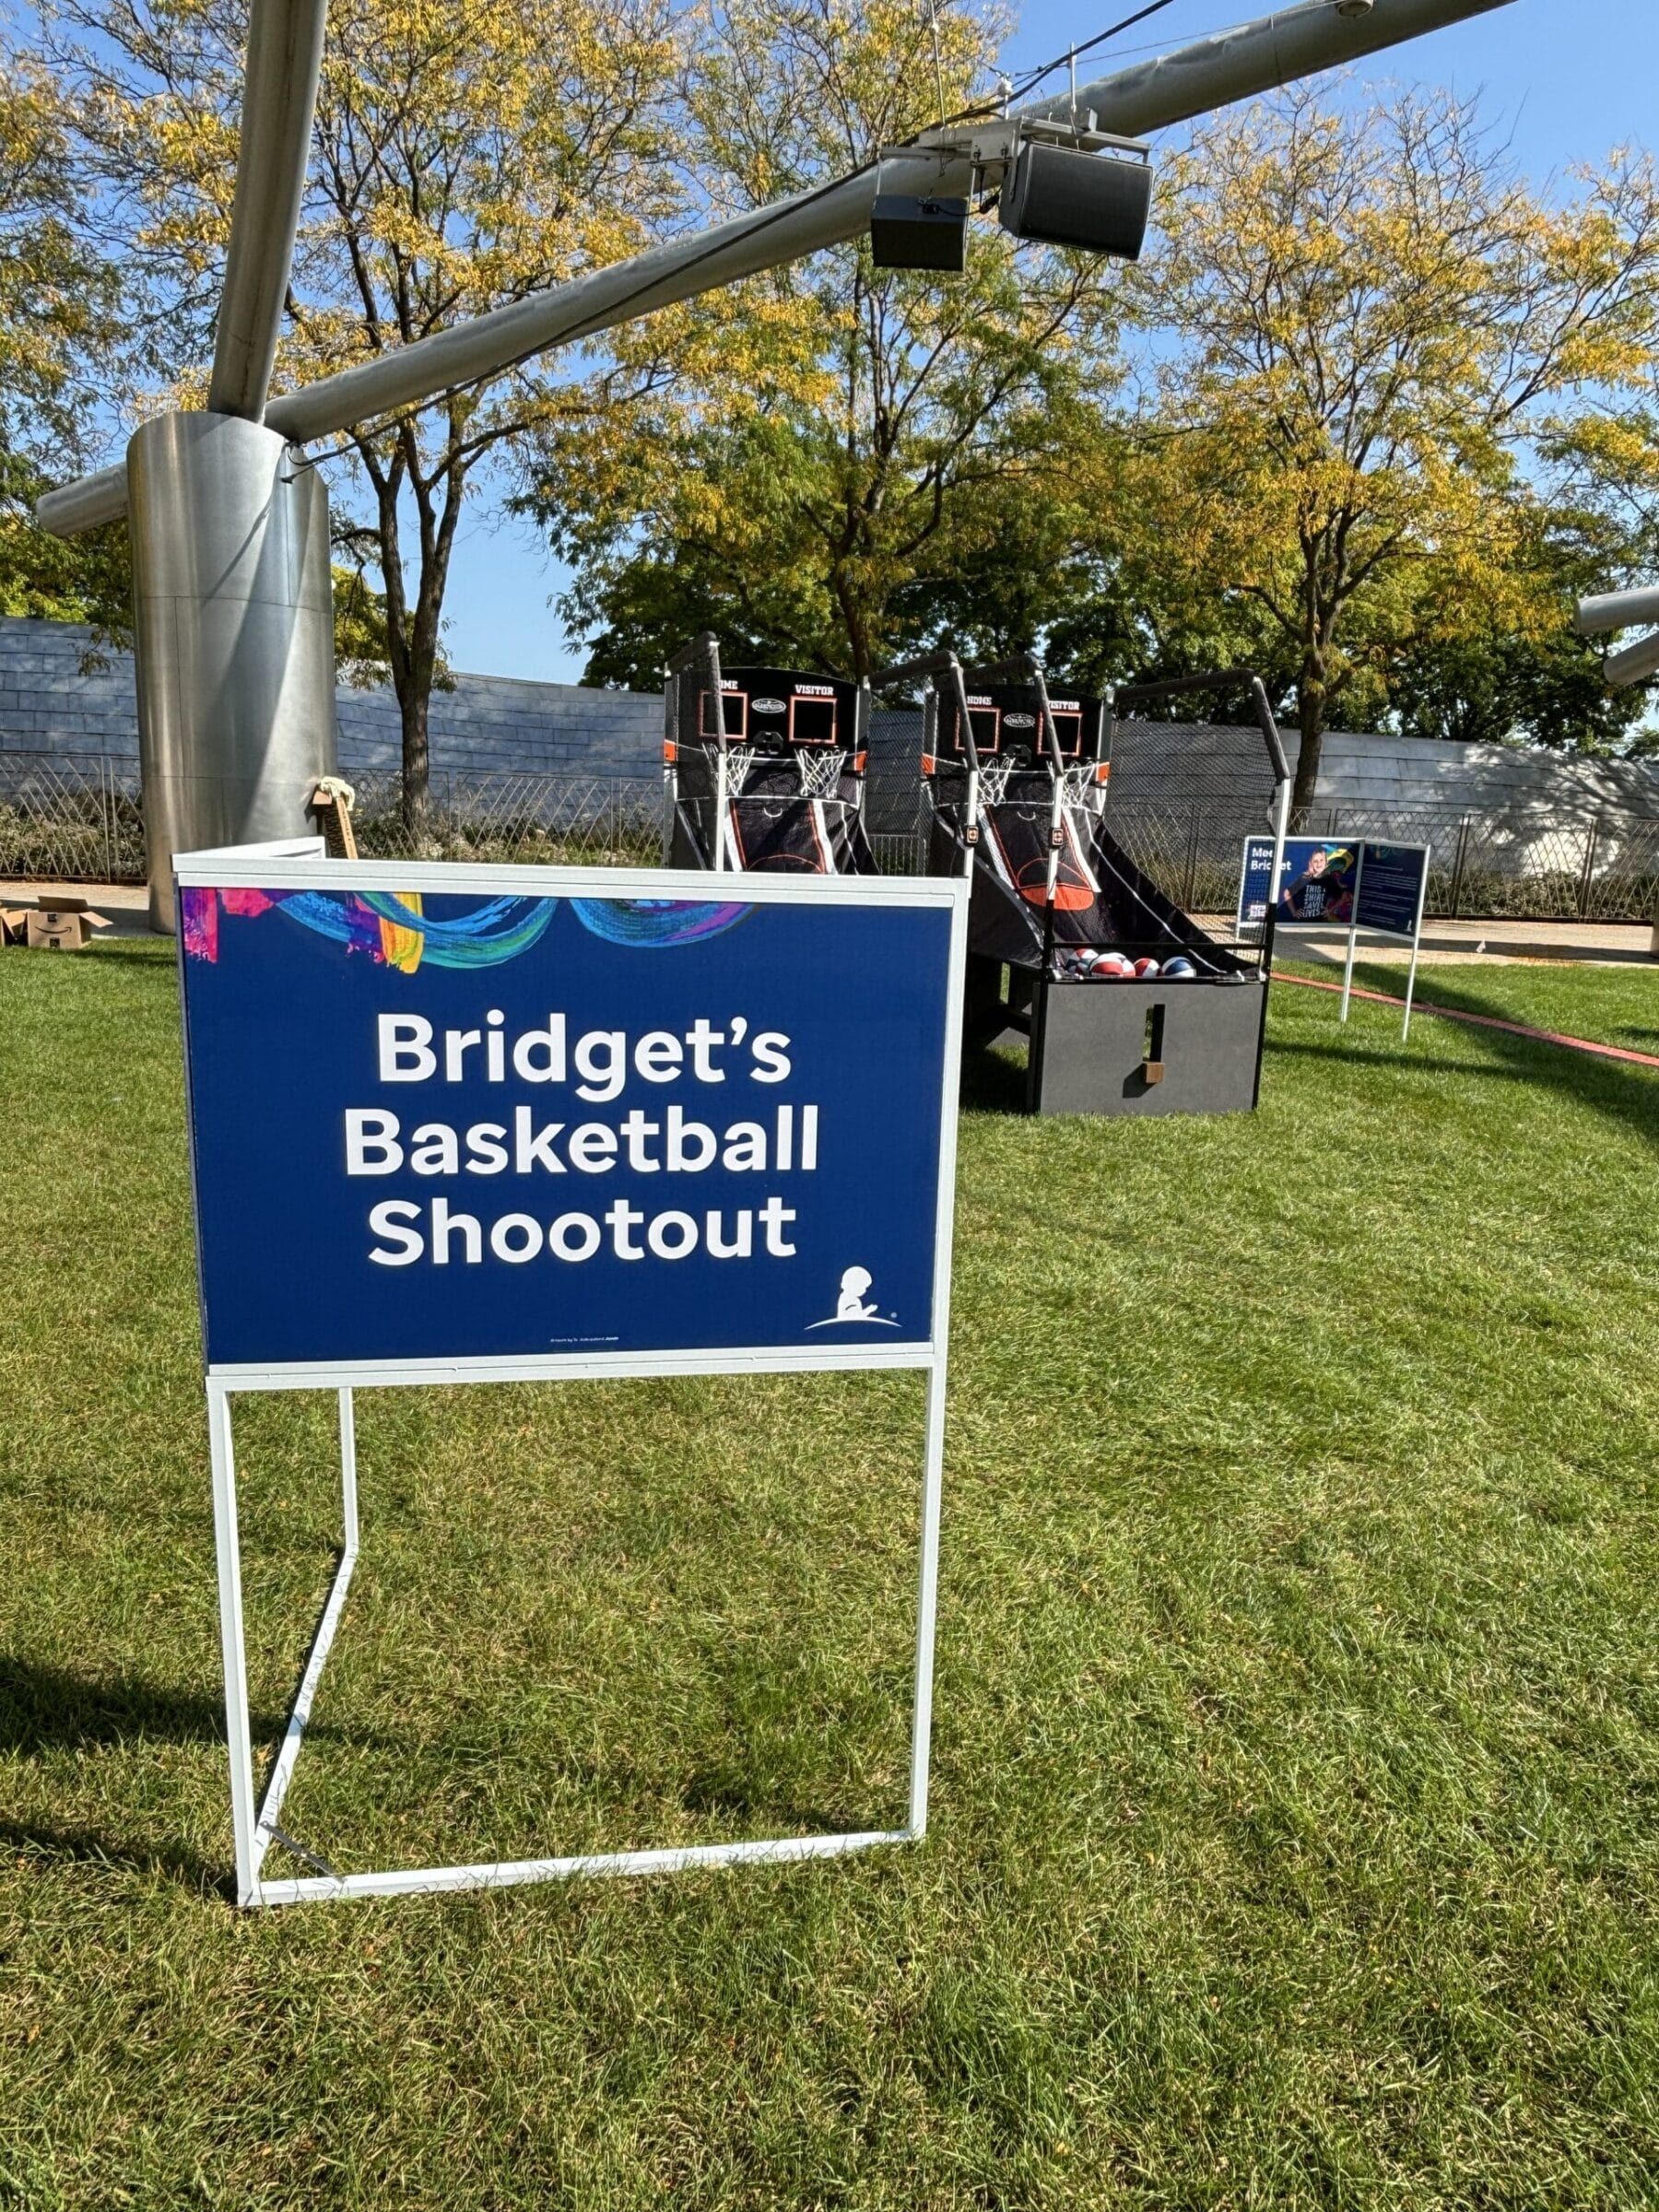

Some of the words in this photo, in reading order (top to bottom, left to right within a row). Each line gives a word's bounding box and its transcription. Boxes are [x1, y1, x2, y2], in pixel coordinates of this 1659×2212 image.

[794, 684, 834, 696] VISITOR
[967, 696, 993, 706] HOME
[1305, 885, 1322, 893] THIS
[1304, 893, 1324, 901] SHIRT
[377, 1008, 792, 1103] Bridget’s
[345, 1104, 818, 1175] Basketball
[368, 1196, 796, 1266] Shootout
